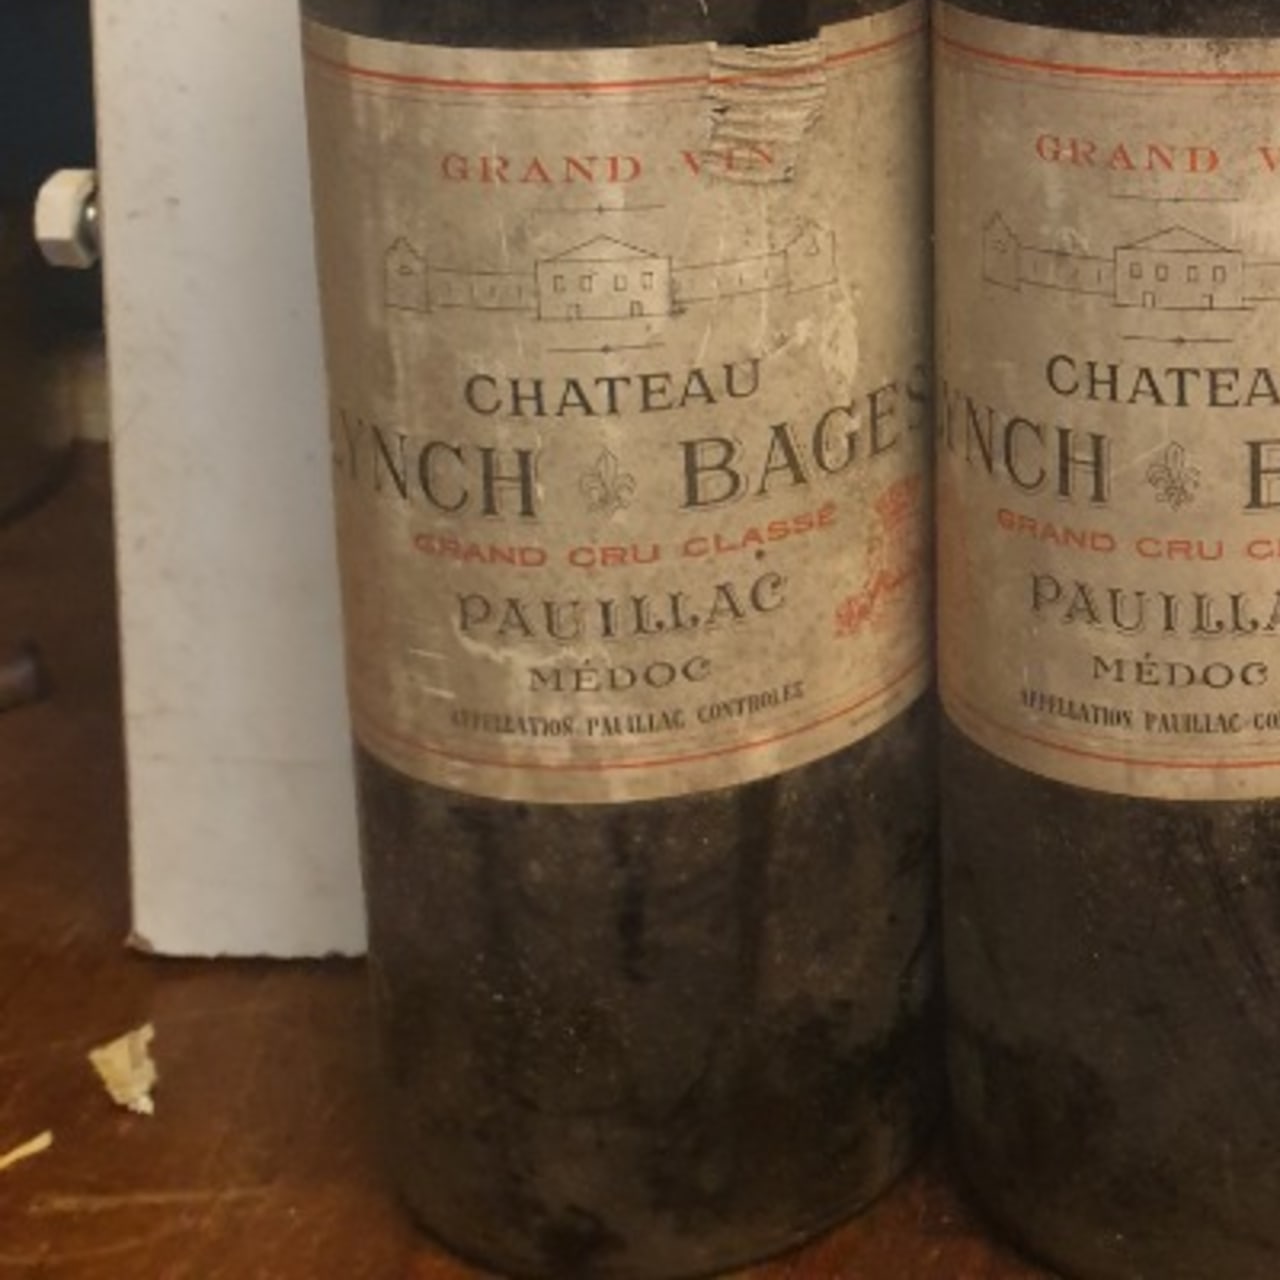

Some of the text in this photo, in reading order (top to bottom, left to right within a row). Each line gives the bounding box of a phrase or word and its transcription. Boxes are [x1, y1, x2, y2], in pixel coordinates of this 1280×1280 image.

[440, 143, 776, 185] GRAND VIN
[1036, 133, 1220, 175] GRAND
[464, 357, 763, 417] CHATEAU
[679, 363, 927, 510] BAGES
[412, 531, 548, 568] GRAND
[568, 543, 661, 568] CRU
[997, 508, 1116, 553] GRAND
[1136, 535, 1224, 560] CRU
[457, 571, 788, 640] PAUILLAC
[528, 655, 712, 693] MÉDOC
[1093, 652, 1269, 689] MÉDOC
[586, 709, 685, 737] PAUILLAC
[1144, 710, 1242, 734] PAUILLAC
